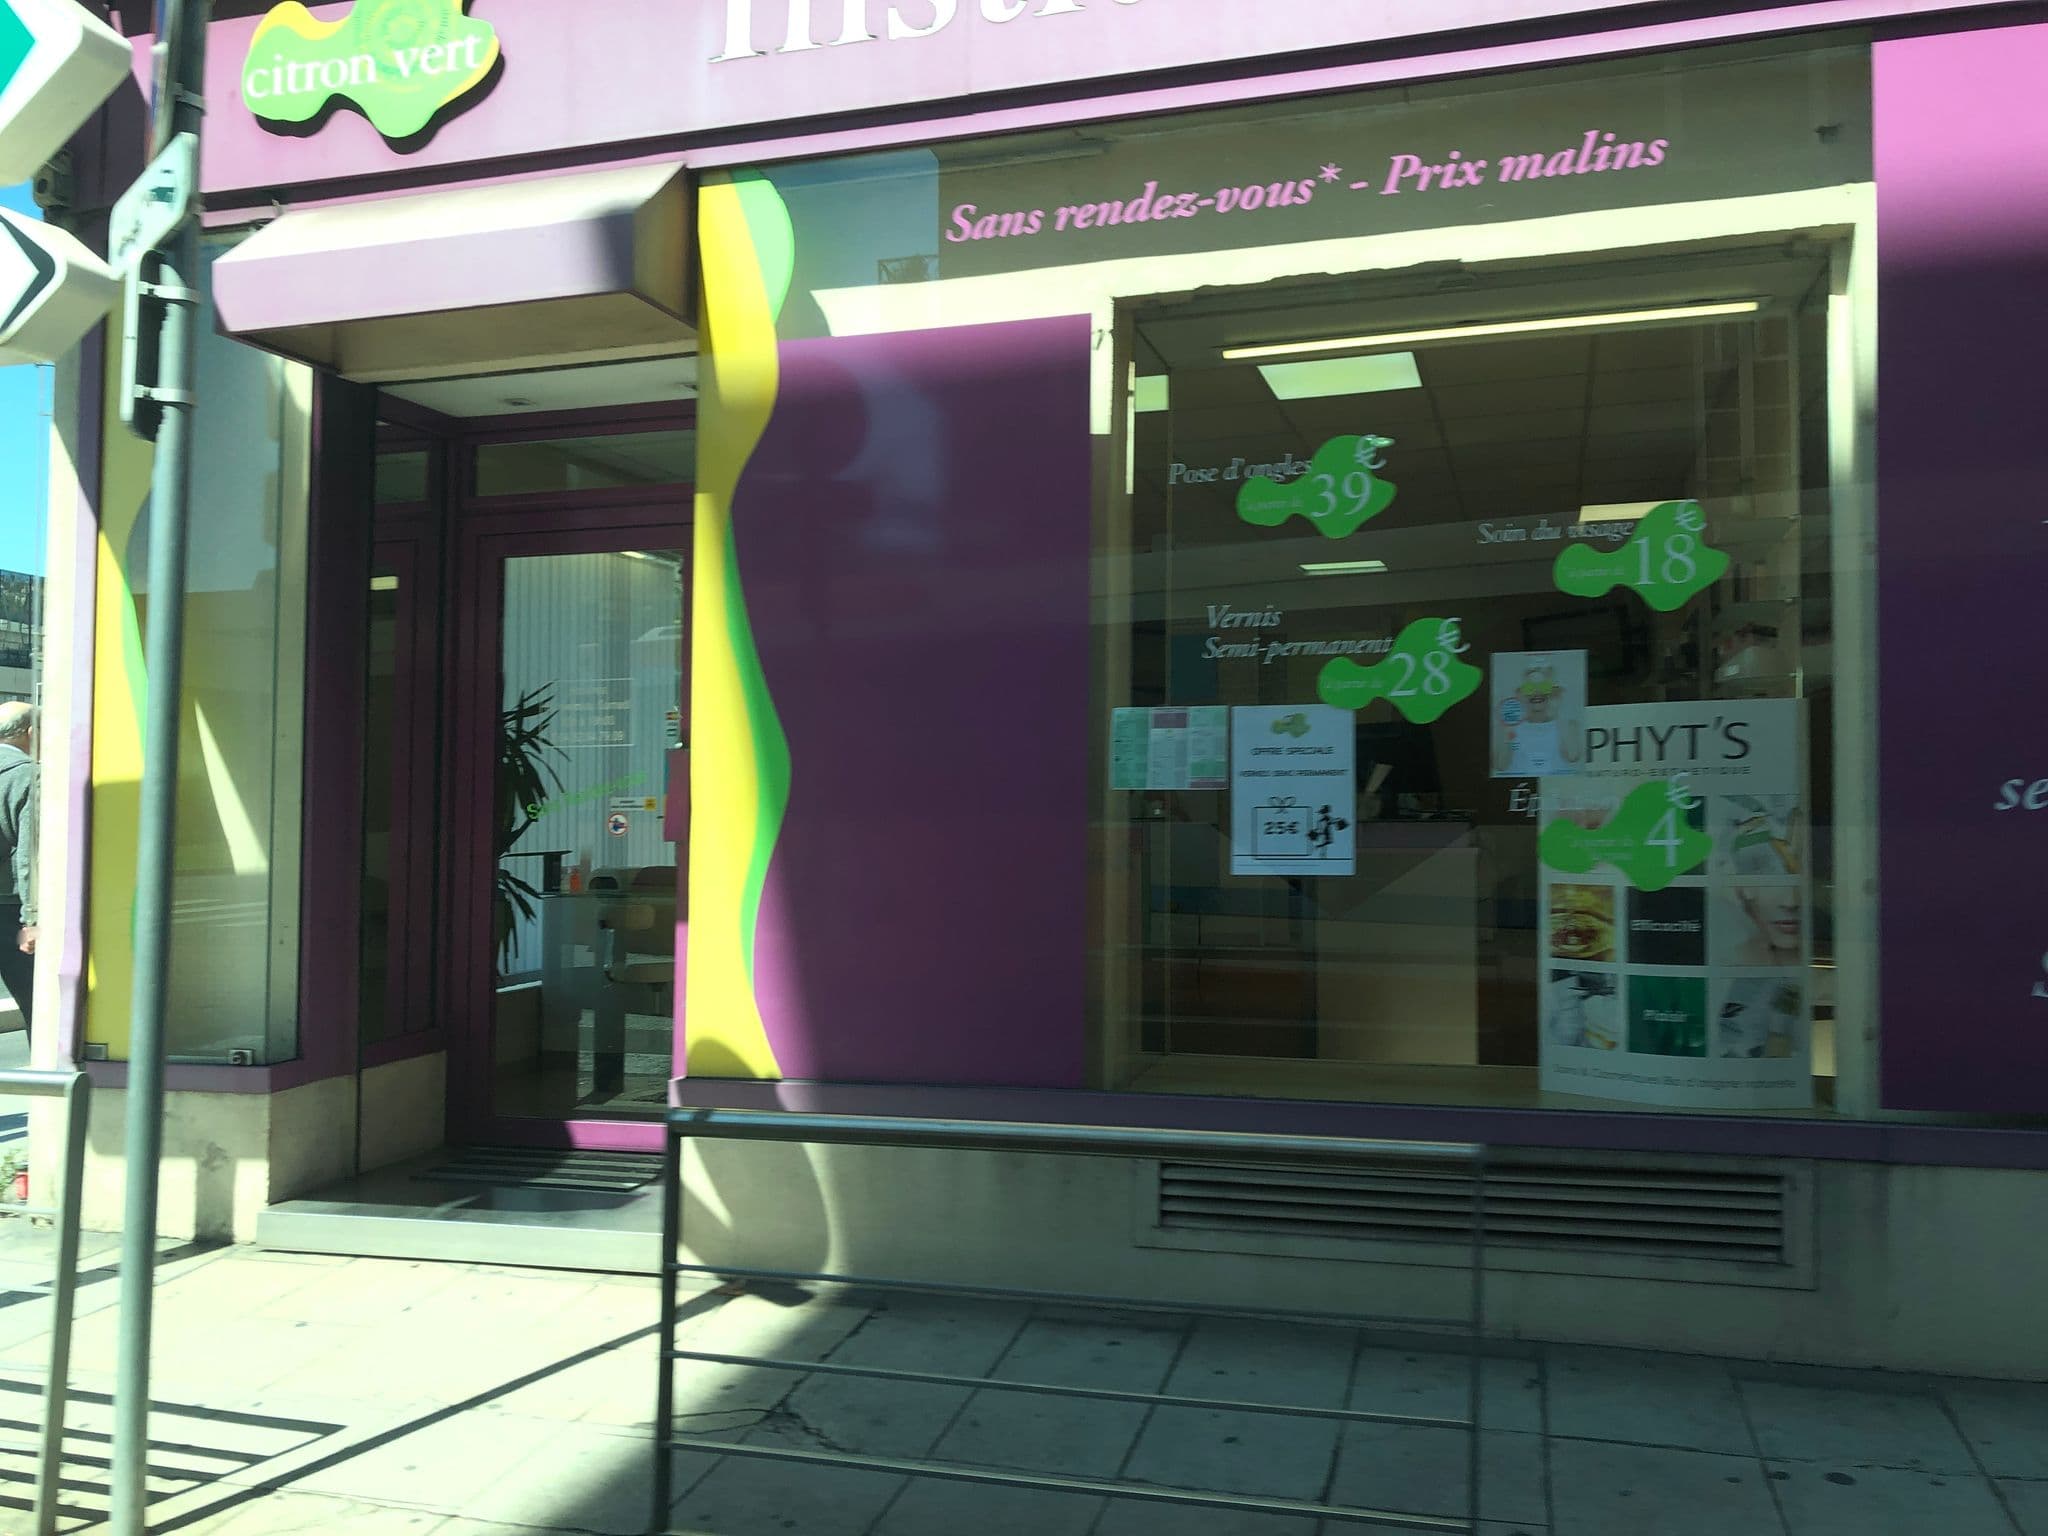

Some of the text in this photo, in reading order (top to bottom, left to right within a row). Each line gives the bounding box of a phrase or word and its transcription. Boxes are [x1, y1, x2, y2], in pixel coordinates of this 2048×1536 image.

[246, 34, 482, 99] citron vert
[945, 203, 1046, 243] Sans
[1379, 149, 1488, 195] Prix
[1497, 129, 1670, 183] malins
[1168, 462, 1219, 485] Pose
[1310, 434, 1390, 517] 39 €
[1477, 519, 1635, 544] Soin du visage
[1633, 498, 1708, 585] 18 €
[1206, 604, 1283, 629] Vernis
[1201, 637, 1394, 665] Semi-permanent
[1387, 617, 1471, 697] 28 €
[1584, 715, 1752, 764] PHYT'S
[1643, 772, 1702, 868] 4 €
